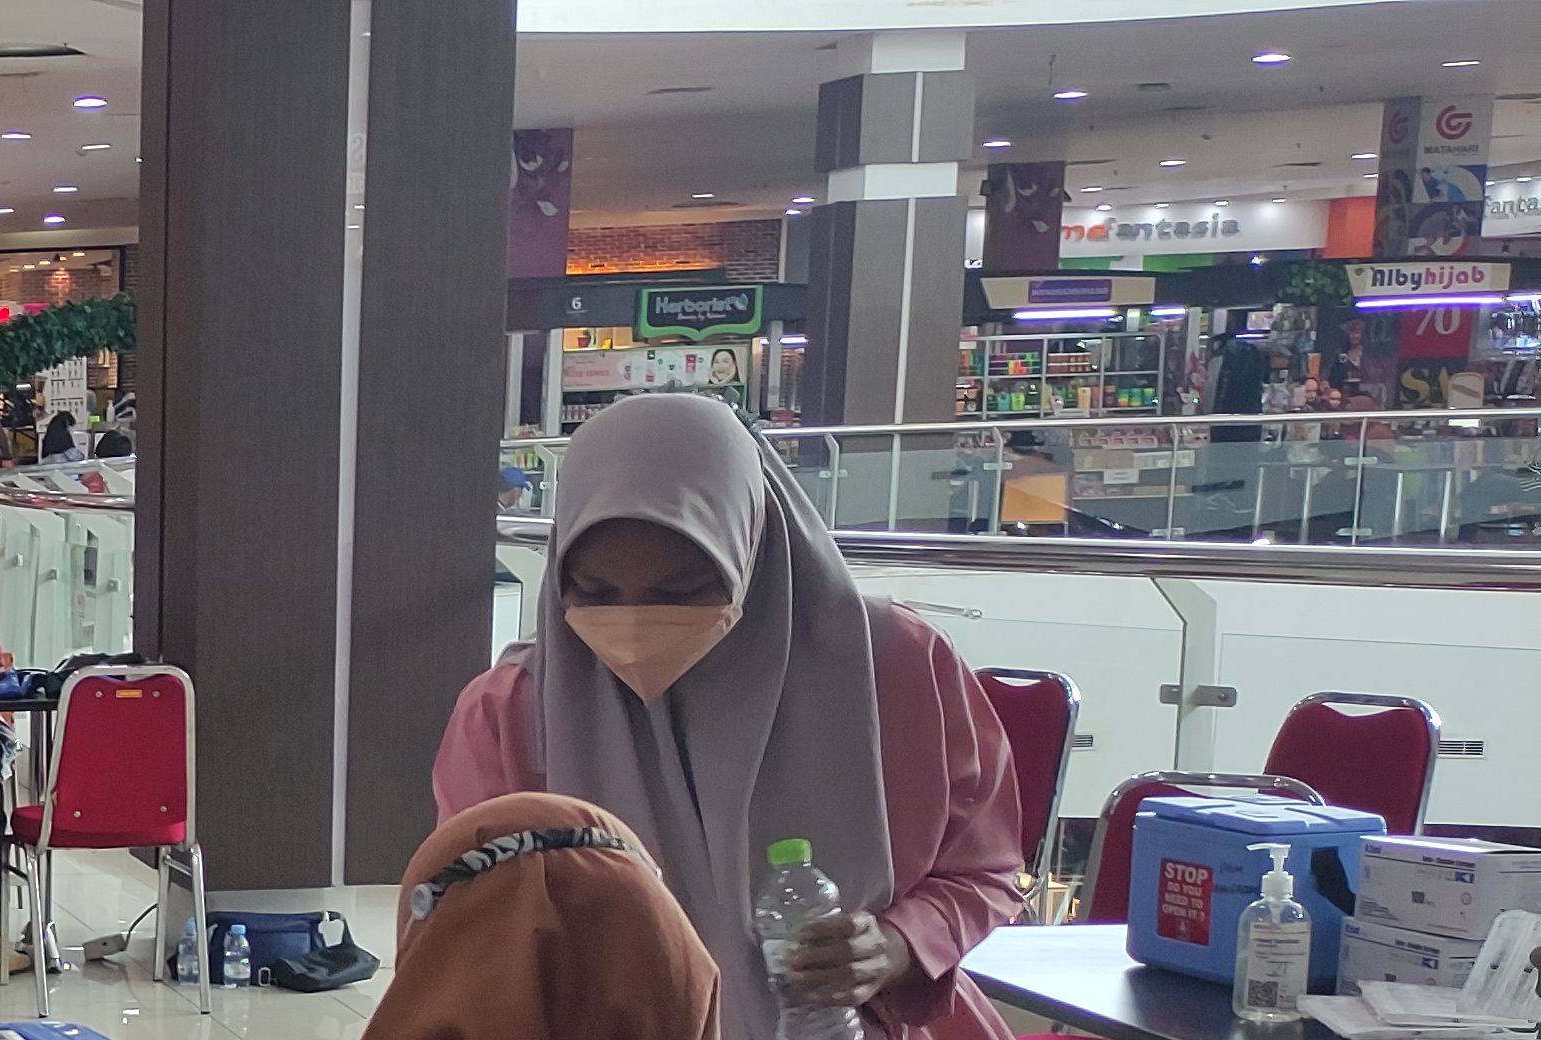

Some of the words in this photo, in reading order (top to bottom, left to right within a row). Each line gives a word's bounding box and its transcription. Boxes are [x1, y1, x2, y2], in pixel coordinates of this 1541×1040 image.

[571, 297, 582, 310] 6
[1164, 862, 1209, 885] STOP
[1182, 884, 1203, 897] YOU
